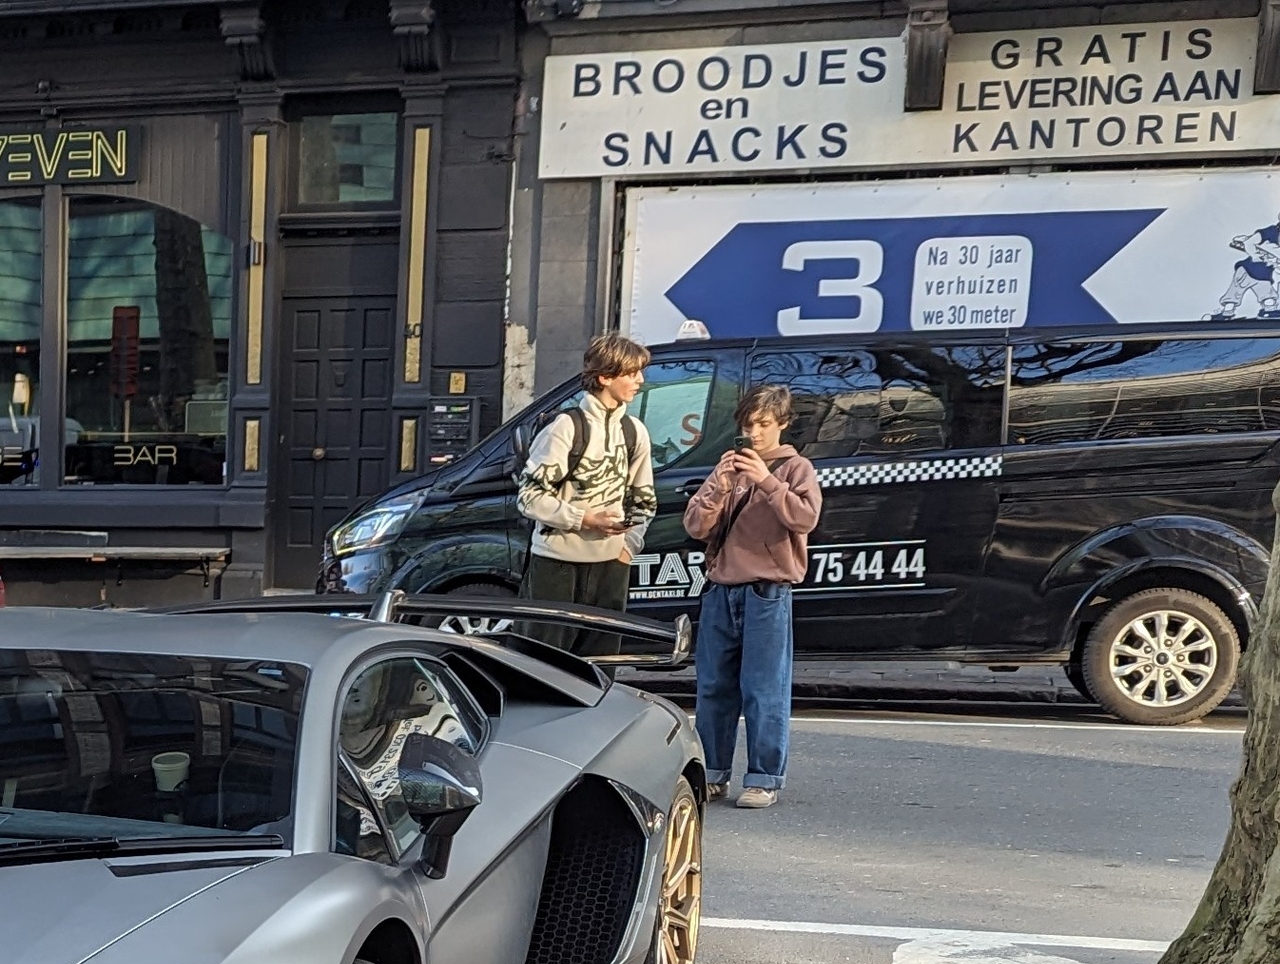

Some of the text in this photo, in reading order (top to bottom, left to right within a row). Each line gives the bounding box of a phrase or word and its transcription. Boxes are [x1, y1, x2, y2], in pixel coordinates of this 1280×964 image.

[990, 27, 1214, 70] GRATIS
[572, 46, 888, 98] BROODJES
[956, 68, 1242, 112] LEVERING AAN
[699, 95, 750, 120] en
[601, 121, 849, 168] SNACKS
[952, 110, 1238, 153] KANTOREN
[927, 244, 1022, 269] Na 30 jaar
[777, 240, 884, 337] 3
[925, 275, 1018, 296] verhuizen
[923, 305, 1017, 326] we 30 meter
[114, 445, 177, 466] BAR
[812, 548, 926, 583] 75 44 44
